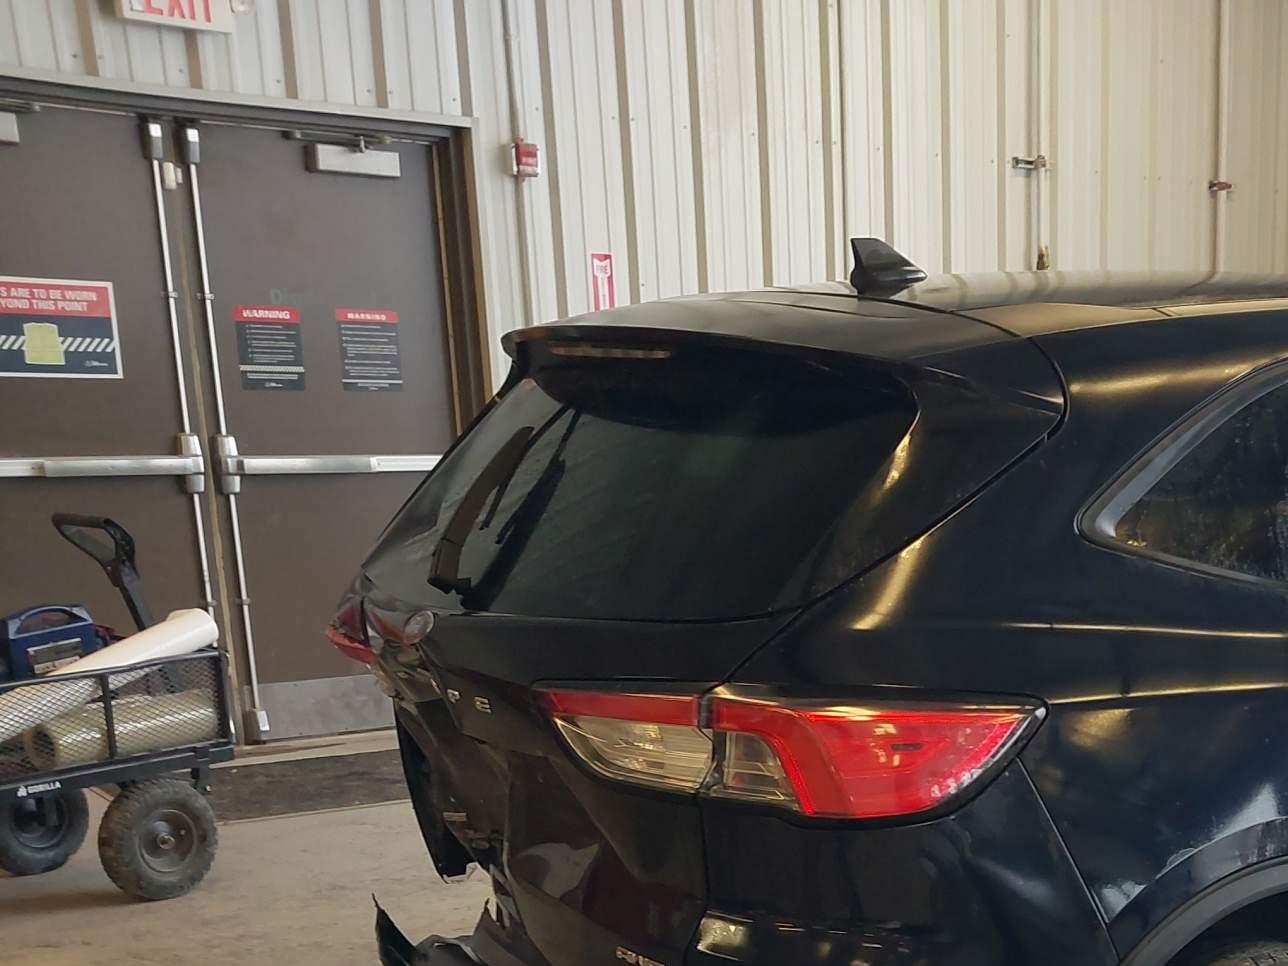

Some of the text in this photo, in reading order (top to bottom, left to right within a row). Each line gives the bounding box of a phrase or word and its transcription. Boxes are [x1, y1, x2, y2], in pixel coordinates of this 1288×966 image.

[10, 287, 32, 299] ARE
[32, 288, 48, 299] TO
[48, 289, 65, 300] BE
[64, 290, 97, 302] WORN
[31, 298, 56, 310] THIS
[57, 300, 89, 312] POINT
[242, 309, 291, 321] WARNING
[346, 312, 387, 322] WARNING
